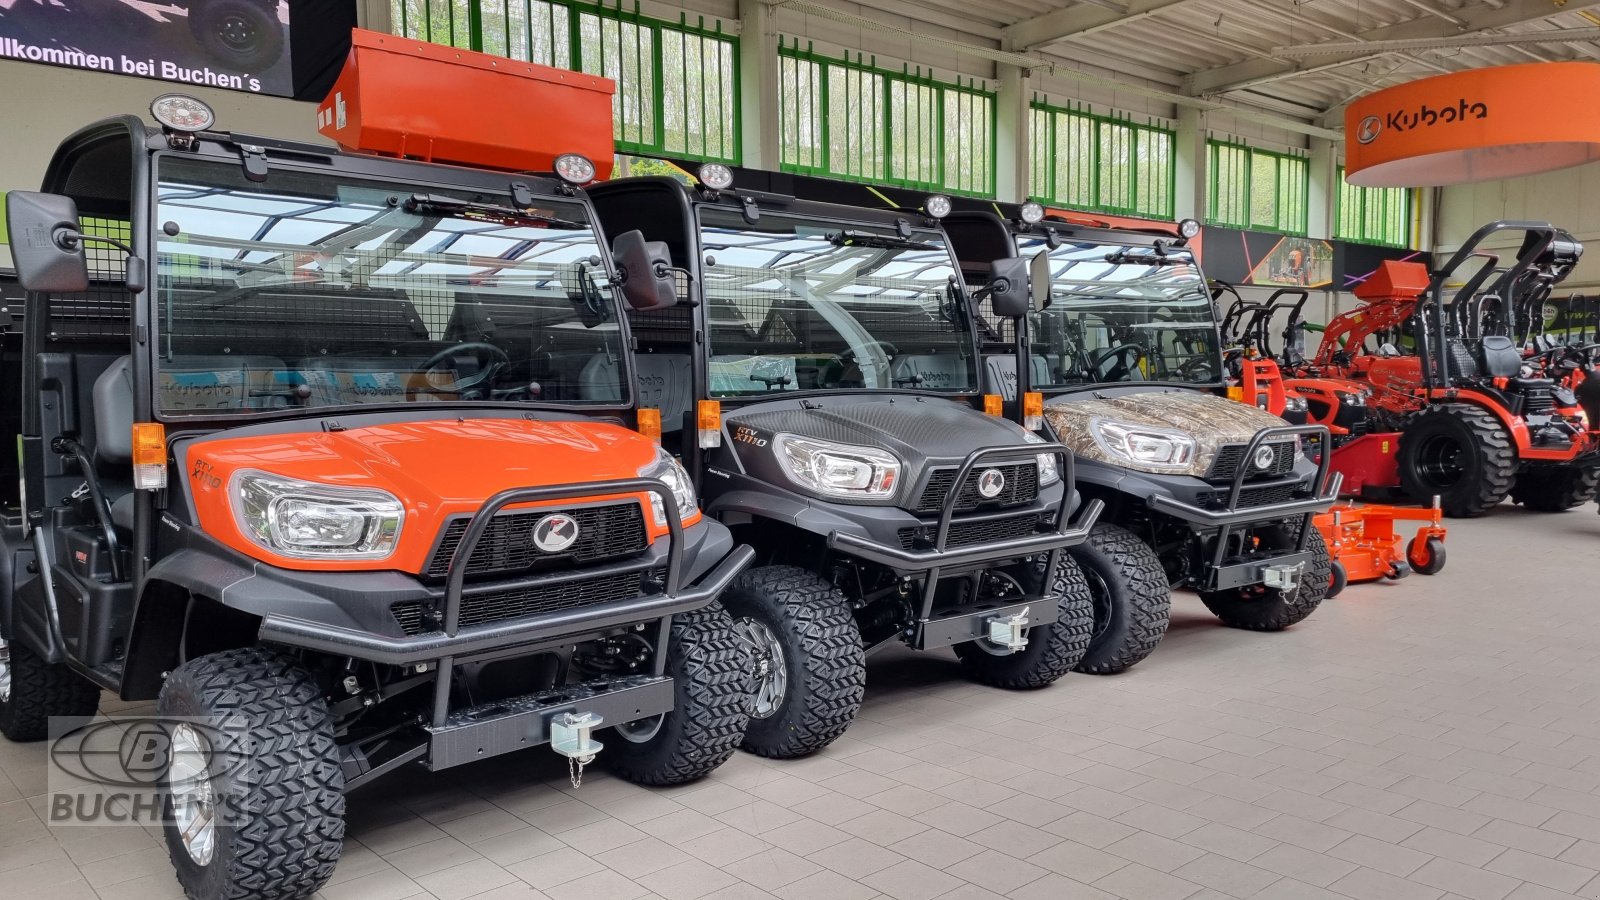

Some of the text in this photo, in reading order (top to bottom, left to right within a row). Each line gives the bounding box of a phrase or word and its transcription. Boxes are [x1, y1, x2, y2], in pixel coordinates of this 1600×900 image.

[121, 55, 155, 76] bei
[1386, 98, 1488, 132] Kubota
[194, 459, 215, 472] RTV
